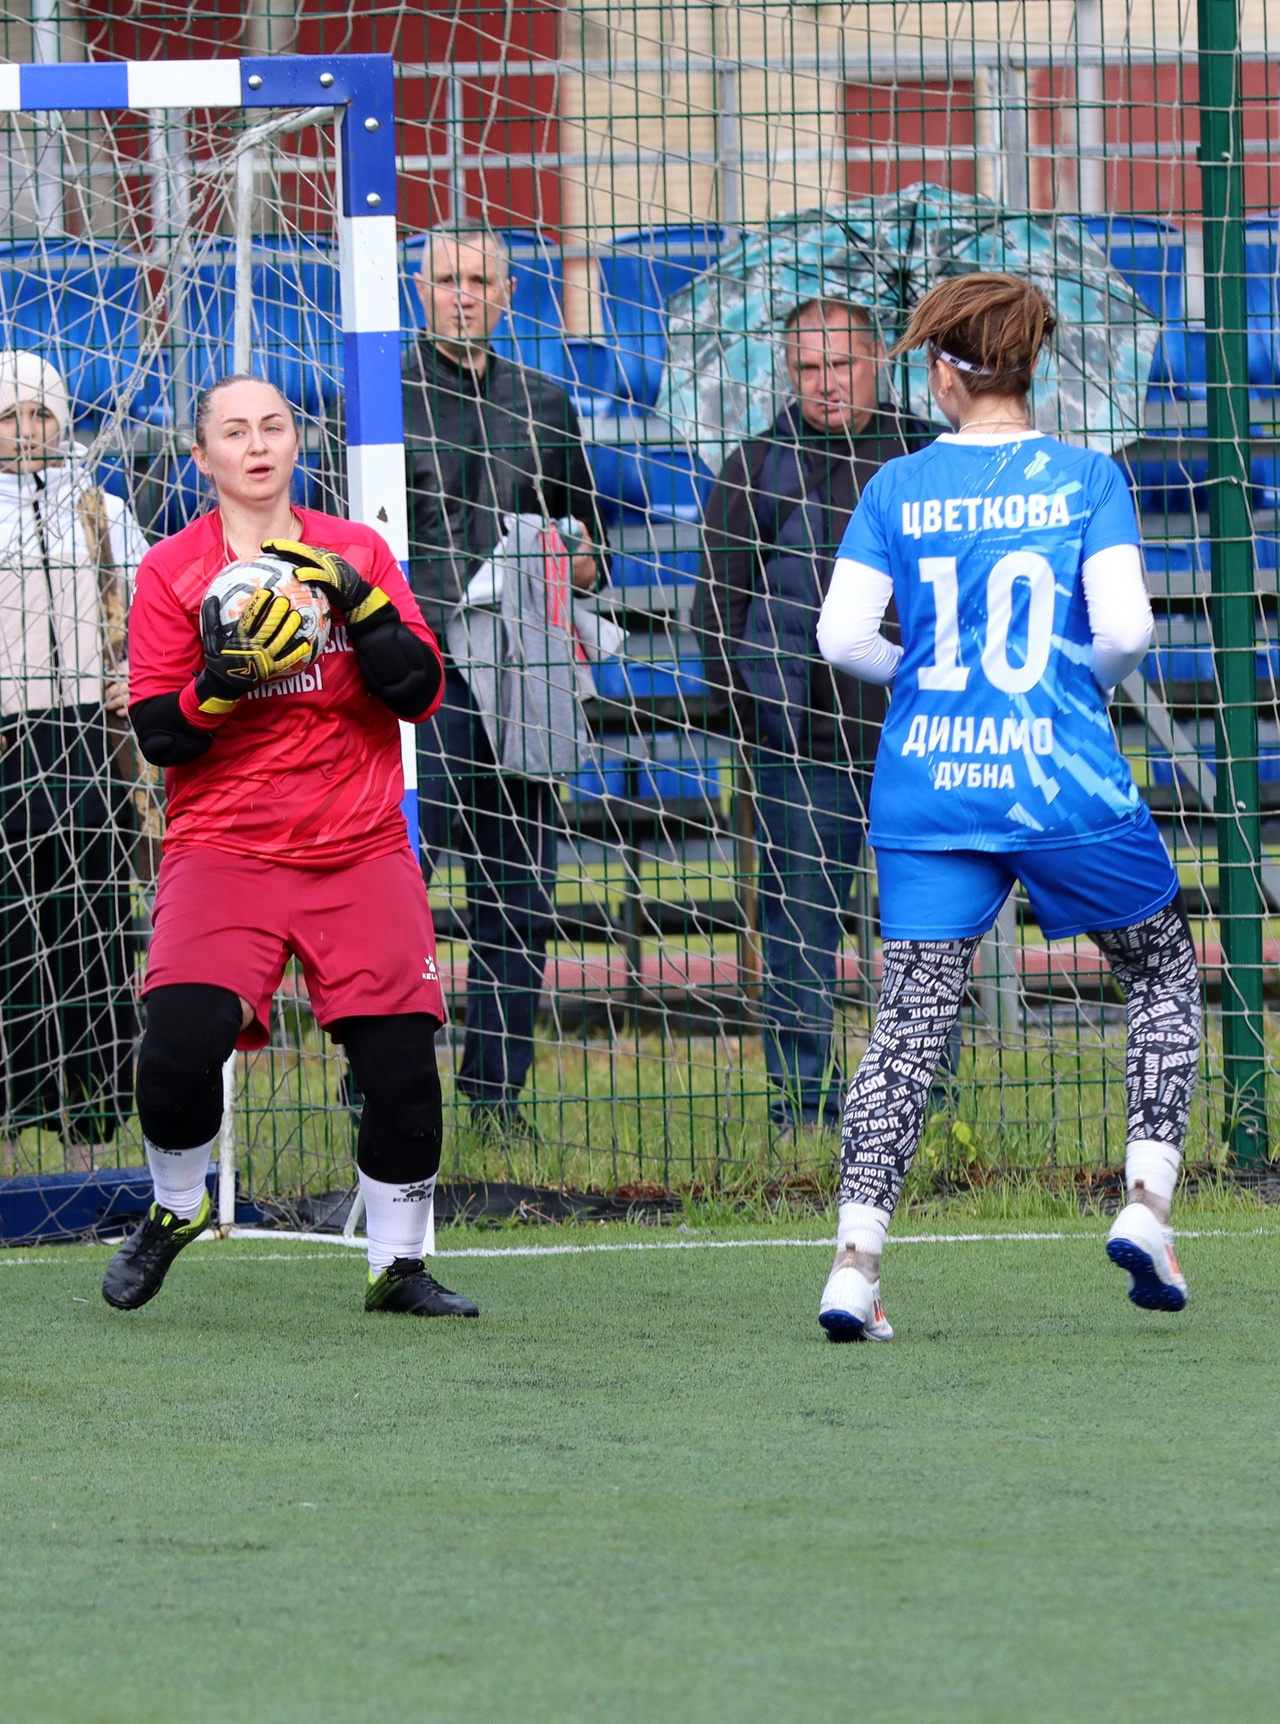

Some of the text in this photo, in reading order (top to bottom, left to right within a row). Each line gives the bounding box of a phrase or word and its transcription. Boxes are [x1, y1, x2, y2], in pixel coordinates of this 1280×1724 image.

[901, 494, 1071, 540] ЦВЕТКОВА
[917, 551, 1056, 694] 10
[901, 714, 1055, 758] ДИНАМО
[933, 760, 1016, 791] ДУБНА
